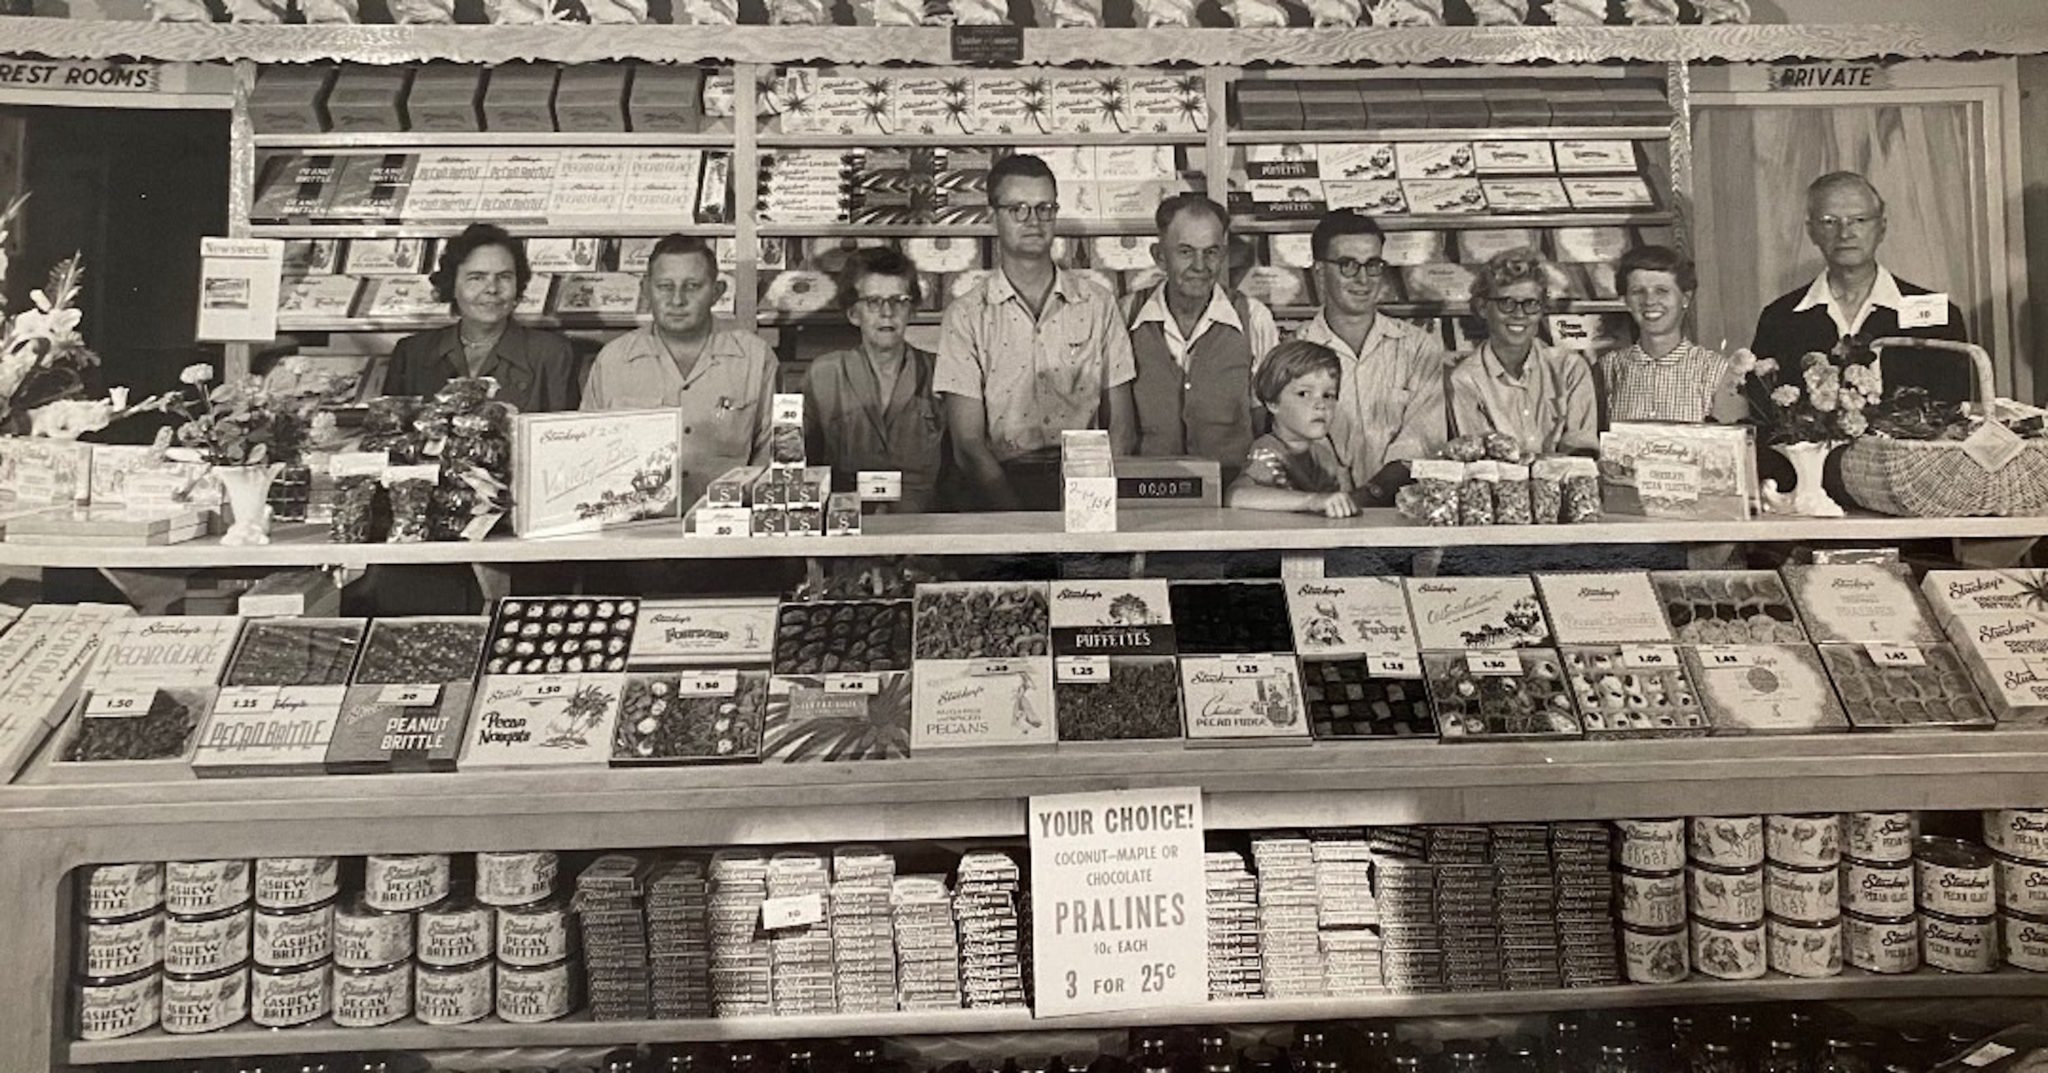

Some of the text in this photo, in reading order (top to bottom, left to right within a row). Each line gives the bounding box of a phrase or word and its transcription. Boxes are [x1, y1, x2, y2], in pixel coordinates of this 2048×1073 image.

[0, 64, 149, 88] REST ROOMS
[1781, 66, 1875, 87] PRIVATE
[205, 242, 269, 254] Newsweek
[1949, 577, 2005, 600] Stuckey's
[1352, 619, 1407, 641] Fudge
[1979, 619, 2036, 644] Stuckey's
[1076, 632, 1152, 648] PUFFETTES
[106, 698, 134, 709] 1.50
[232, 698, 258, 709] 1.25
[386, 717, 450, 732] PEANUT
[481, 711, 527, 730] Pecan
[926, 721, 990, 736] PECANS
[1196, 717, 1232, 727] PECAN
[210, 719, 327, 752] PECAN BRITTLE
[380, 734, 445, 750] BRITTLE
[477, 730, 532, 747] Nougats
[1039, 803, 1194, 839] YOUR CHOICE!
[1054, 844, 1179, 867] COCONUT-MAPLE OR
[387, 877, 432, 892] PECAN
[1086, 868, 1152, 887] CHOCOLATE
[1939, 872, 1990, 889] Stuckey's
[382, 886, 436, 903] BRITTLE
[1055, 892, 1186, 935] PRALINES
[432, 934, 476, 947] PECAN
[506, 935, 547, 947] PECAN
[1925, 923, 1982, 945] Stuckey's
[272, 940, 327, 959] BRITTLE
[426, 943, 477, 957] BRITTLE
[1118, 939, 1148, 954] EACH
[1065, 969, 1078, 999] 3
[1093, 977, 1125, 995] FOR
[263, 991, 320, 1008] CASHEW
[342, 996, 387, 1009] PECAN
[263, 1002, 319, 1018] BRITTLE
